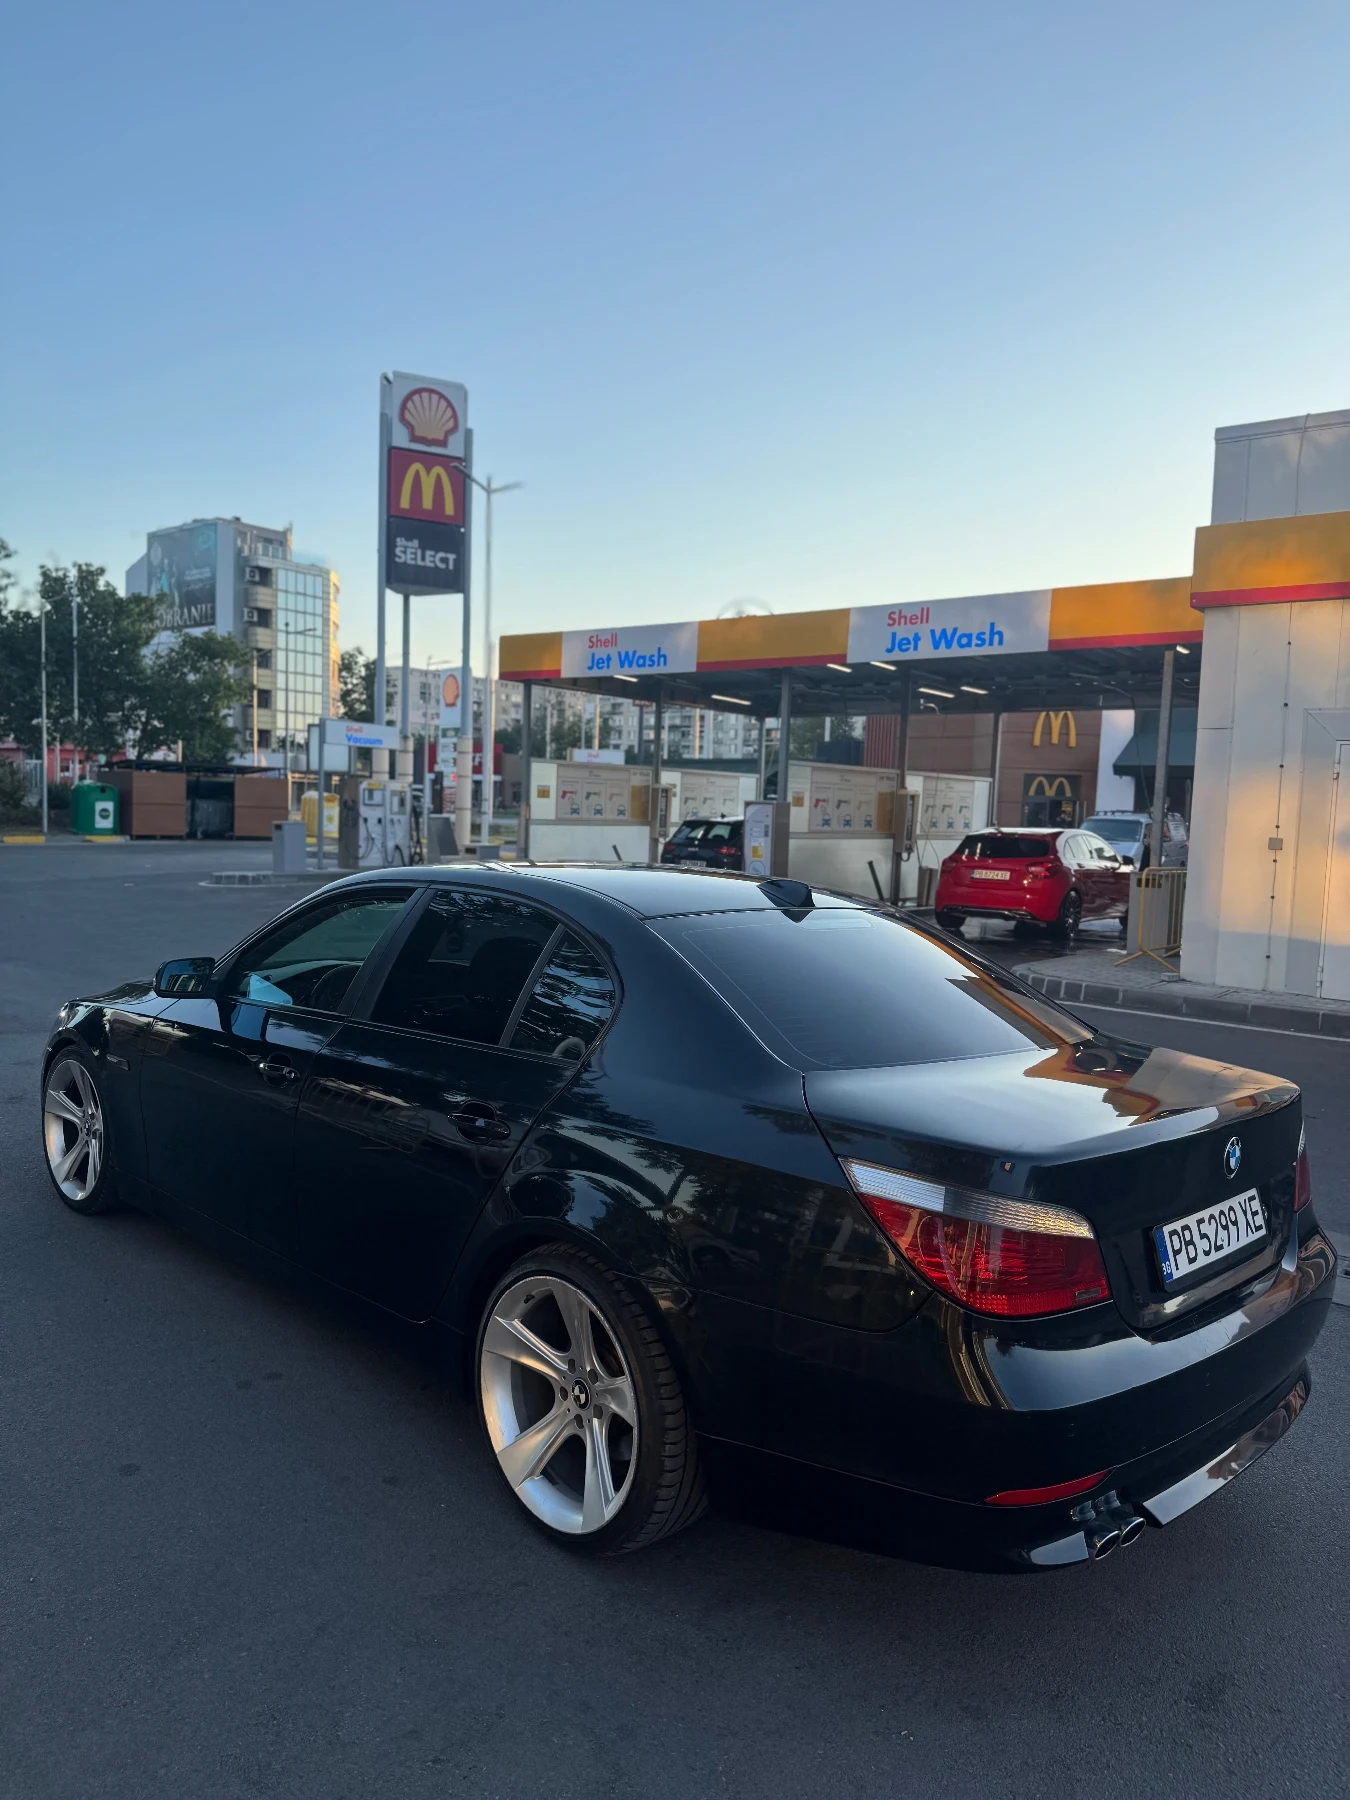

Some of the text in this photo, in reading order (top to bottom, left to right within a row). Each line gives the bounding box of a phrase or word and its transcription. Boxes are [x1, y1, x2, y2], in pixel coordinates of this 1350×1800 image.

[396, 538, 419, 548] Shell
[395, 548, 456, 570] SELECT
[152, 604, 214, 628] OBRANIE
[887, 606, 931, 627] Shell
[588, 633, 618, 649] Shell
[884, 621, 1005, 654] Jet Wash
[586, 647, 667, 671] Jet Wash
[345, 734, 383, 745] Vacuum
[984, 870, 1000, 878] 8724
[1168, 1194, 1264, 1271] PB 5299 XE
